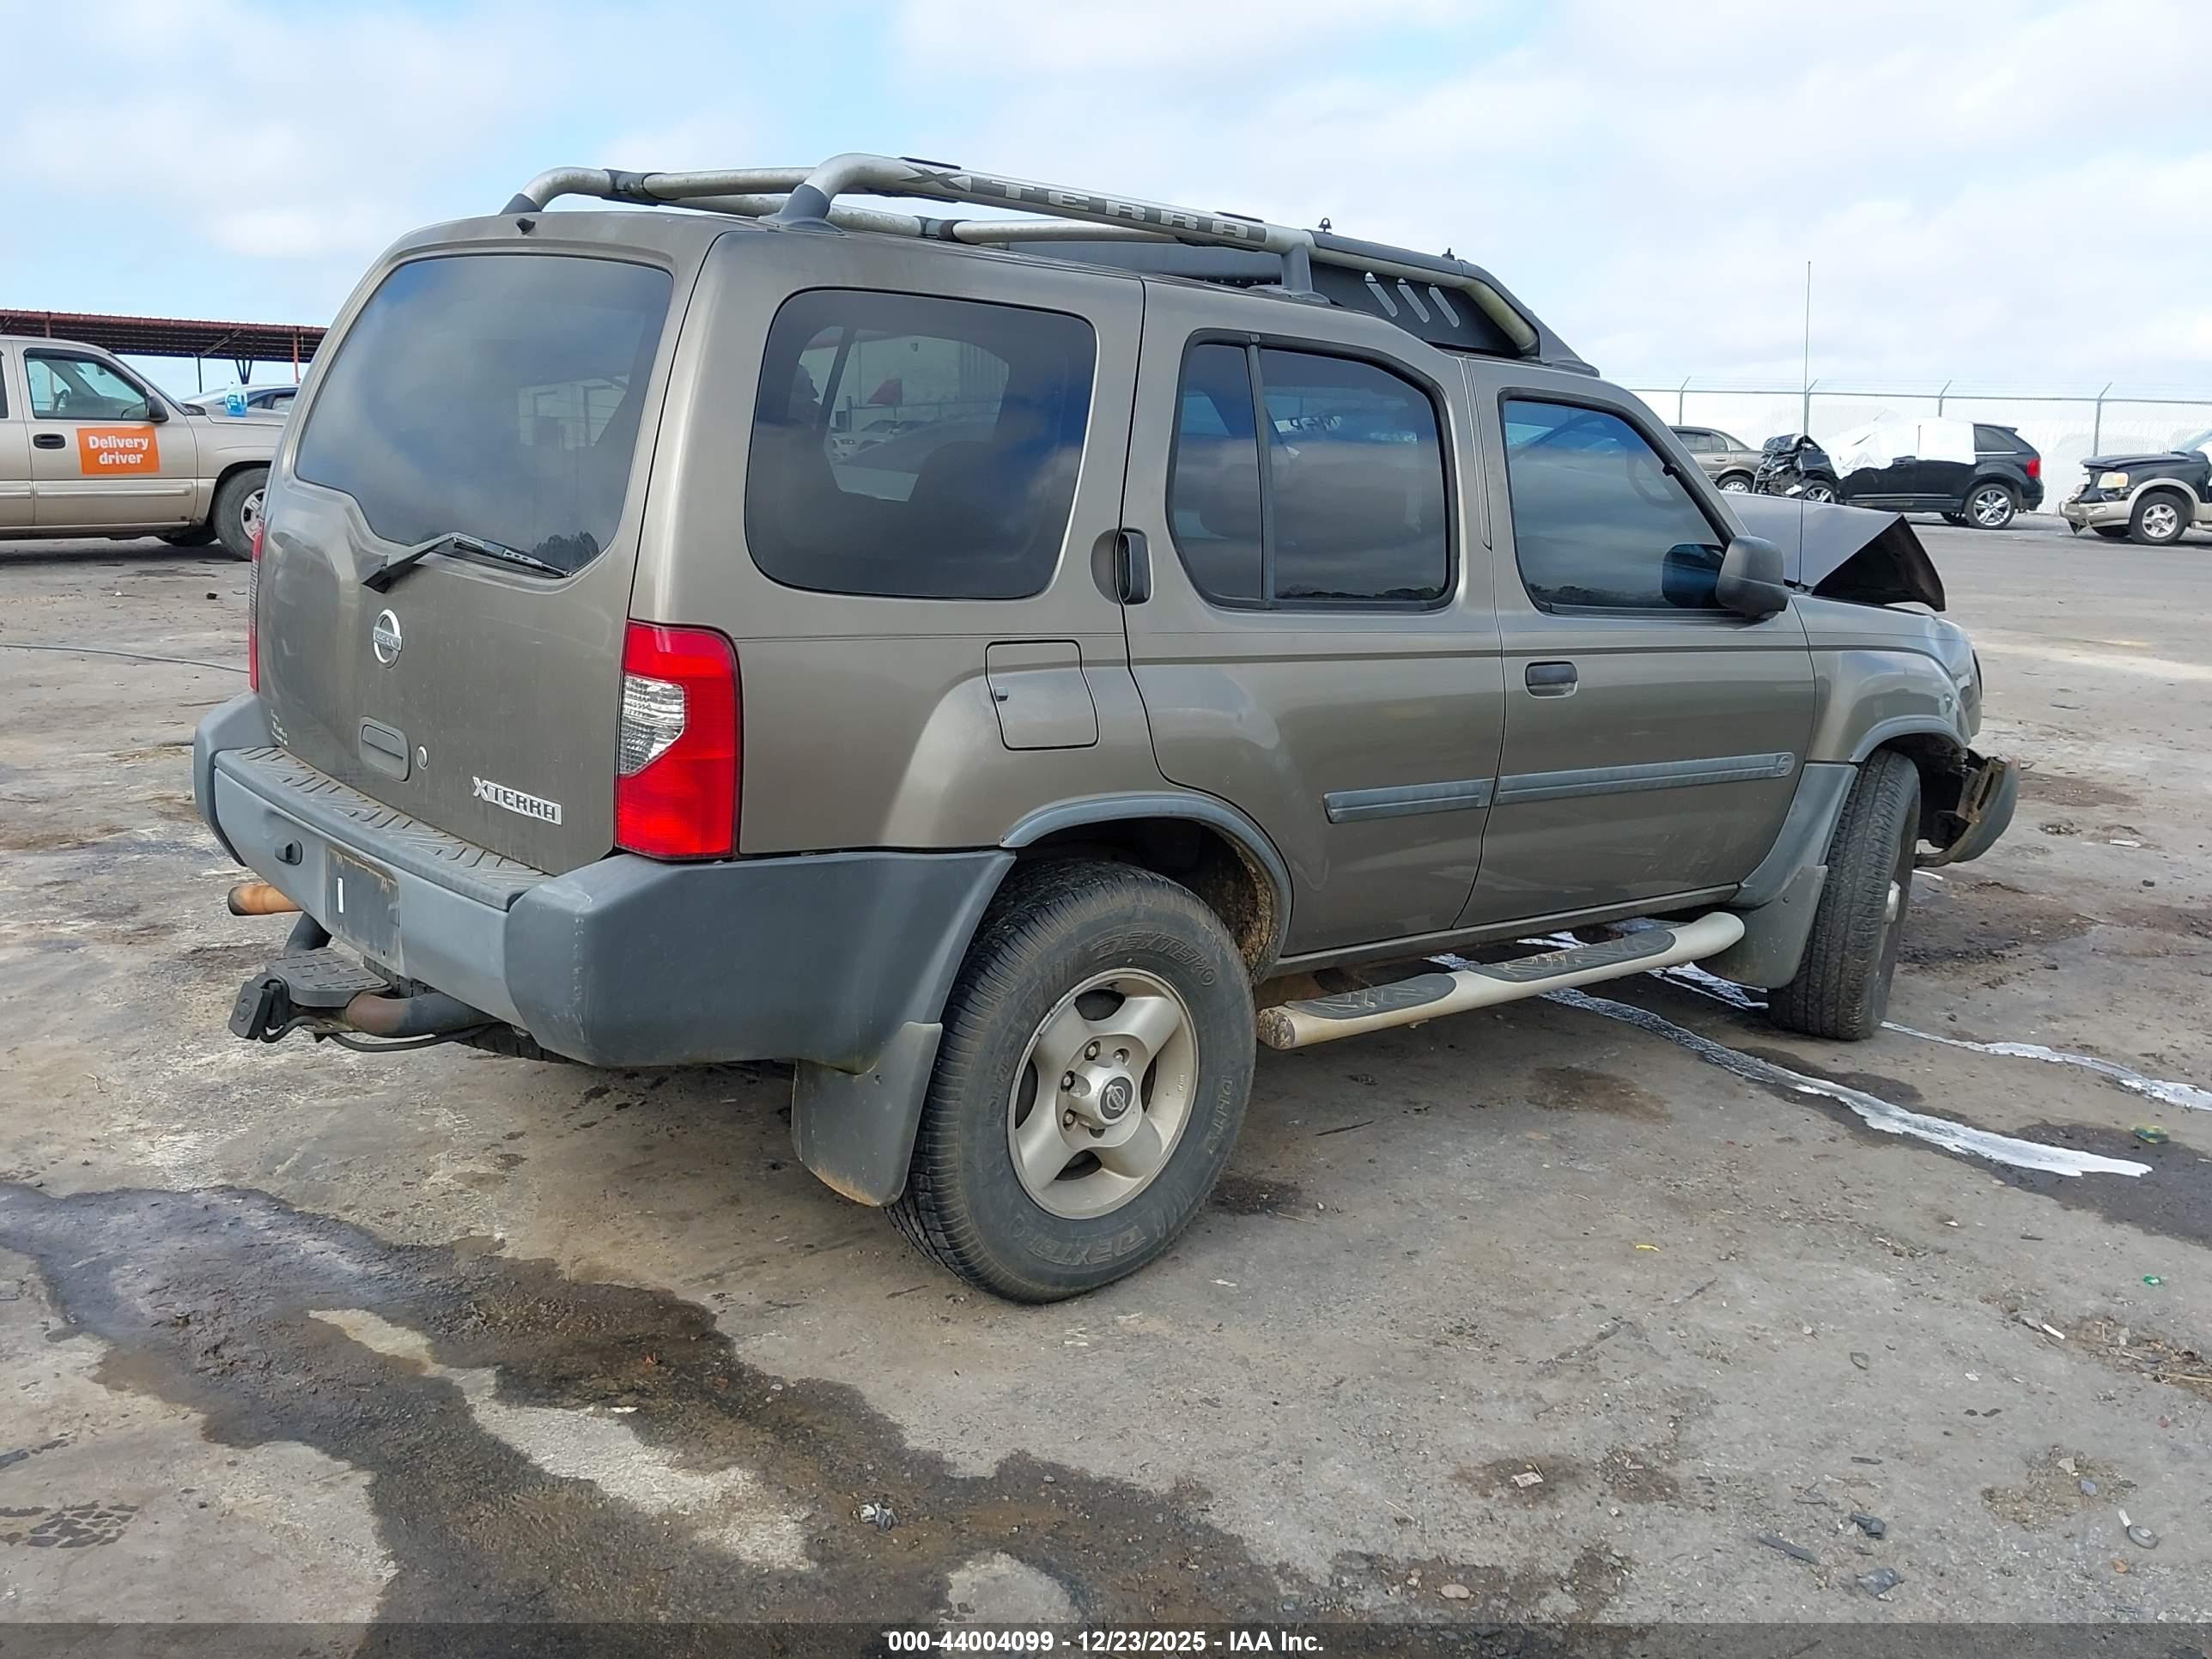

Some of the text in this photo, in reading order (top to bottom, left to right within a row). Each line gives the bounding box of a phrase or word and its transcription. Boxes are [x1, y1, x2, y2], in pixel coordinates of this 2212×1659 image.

[904, 164, 1251, 240] XTERRA
[88, 435, 149, 450] Delivery
[99, 452, 143, 465] driver
[472, 776, 558, 823] XTERRA
